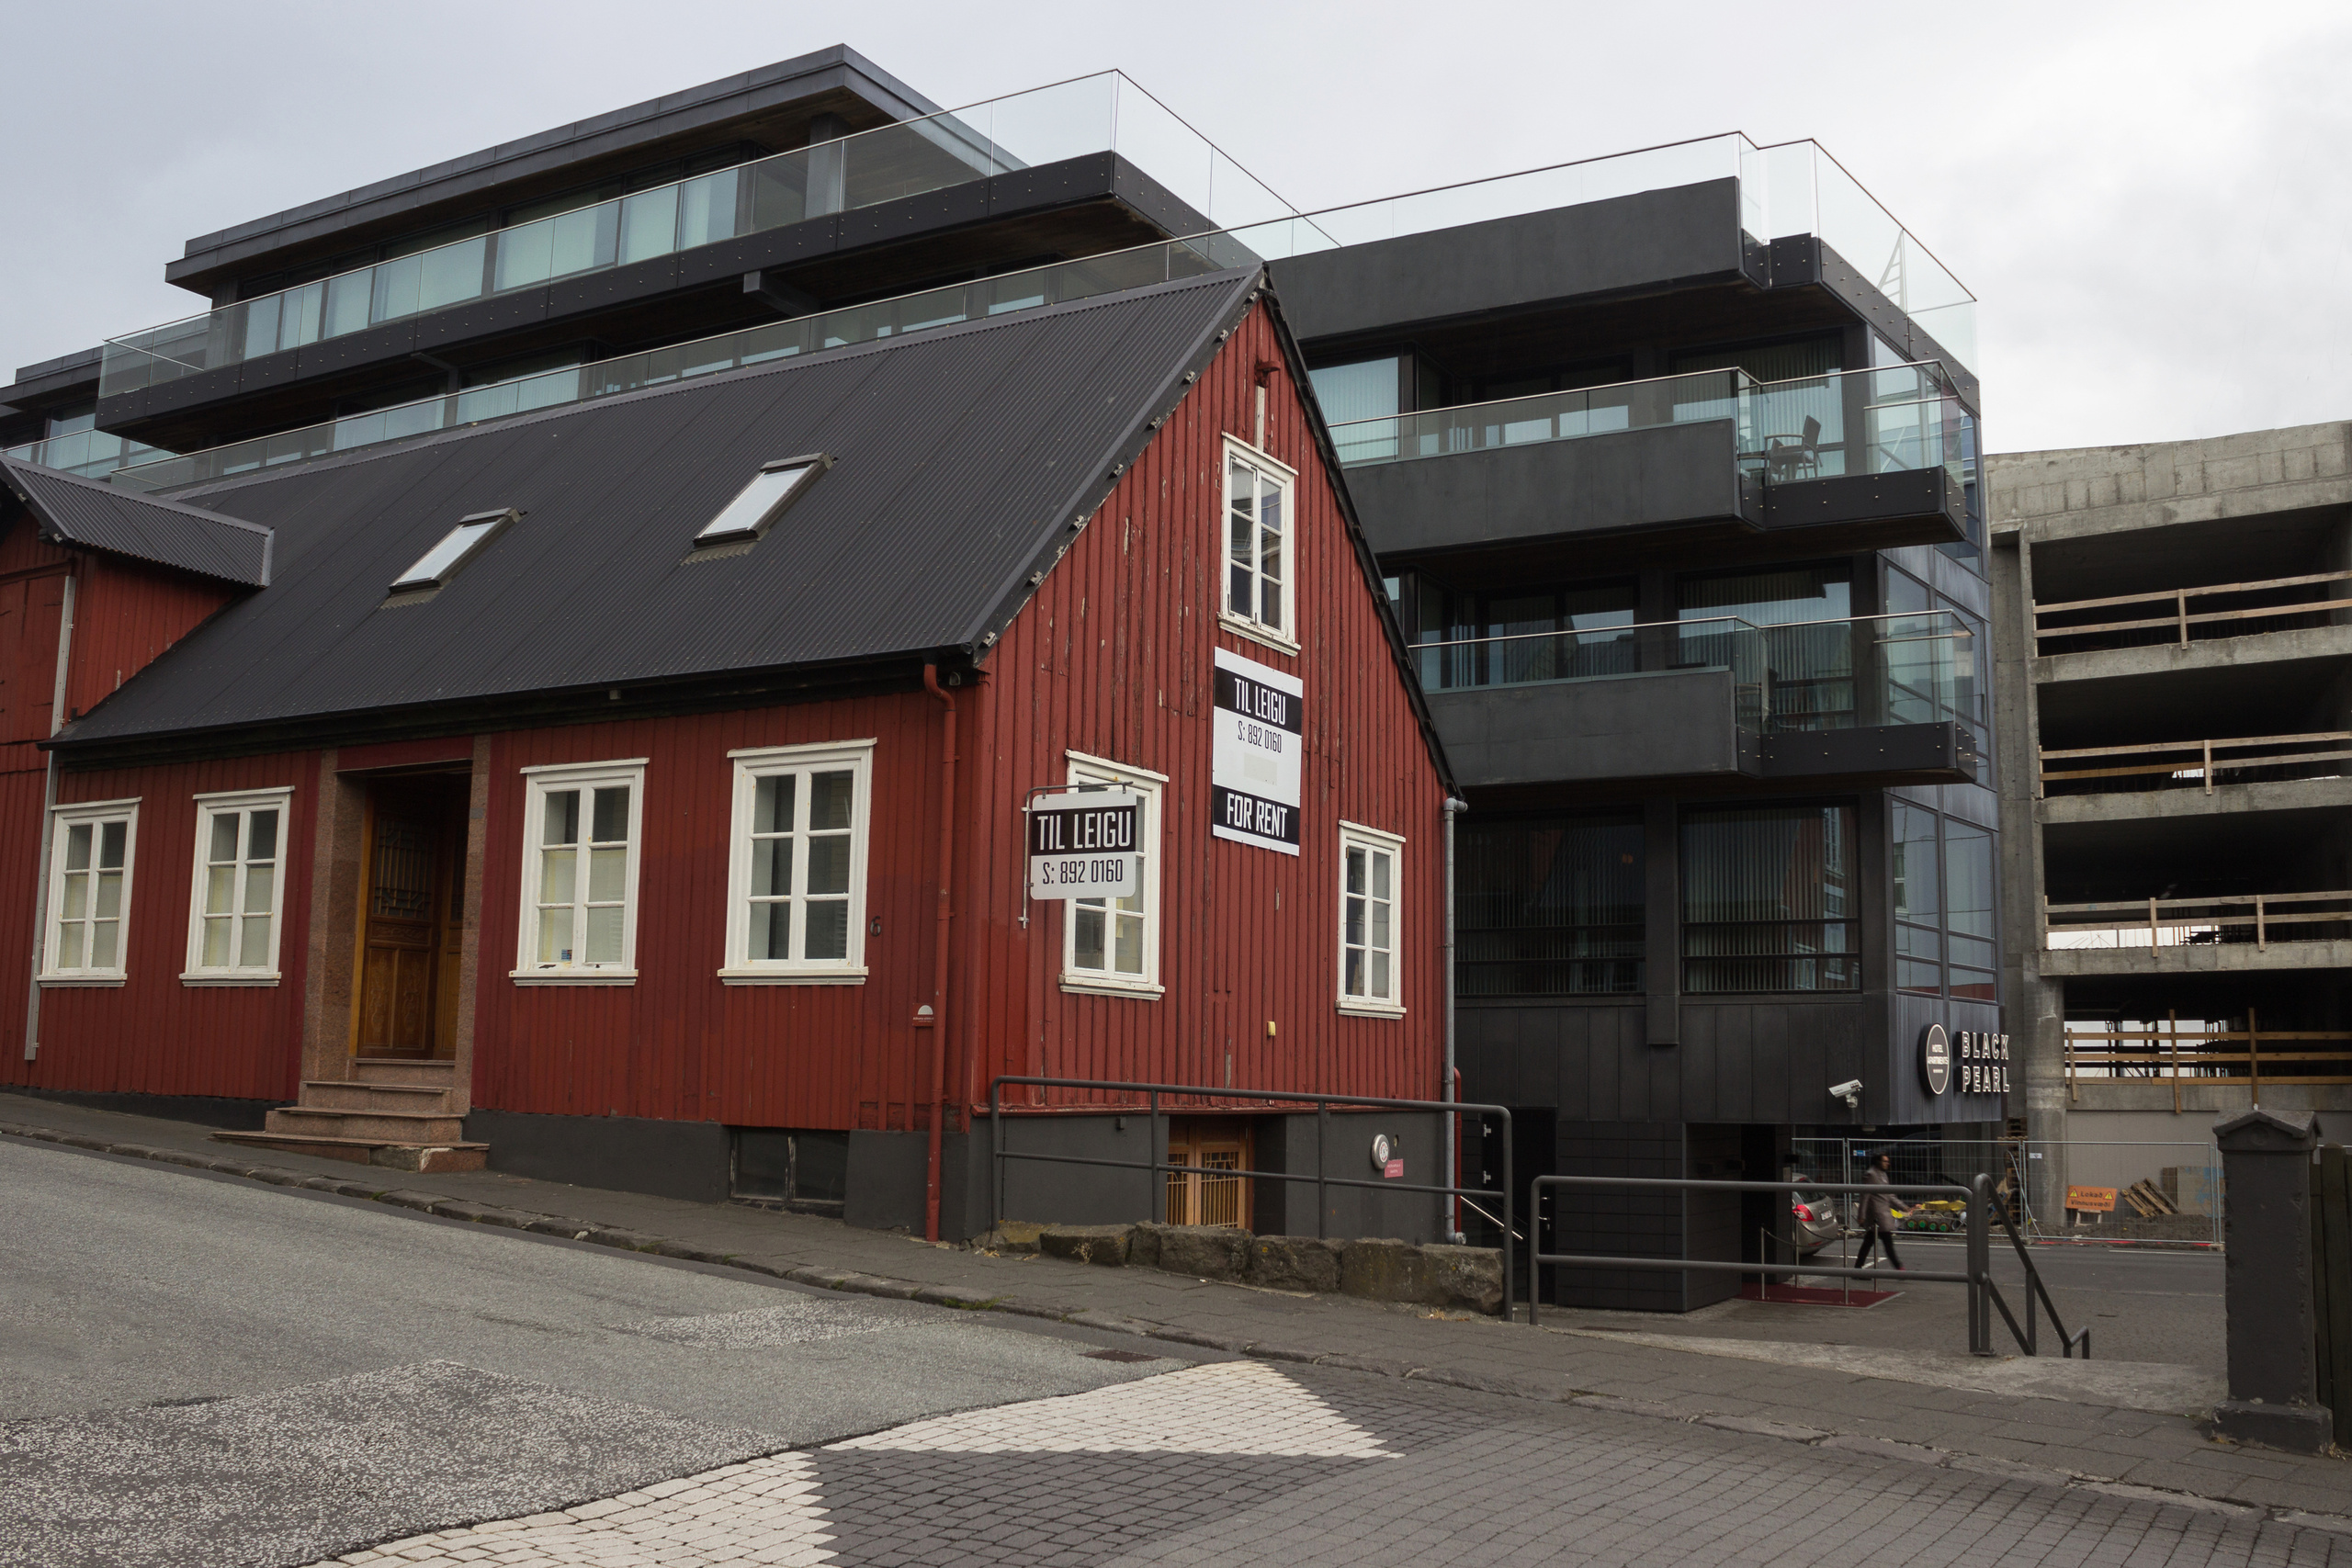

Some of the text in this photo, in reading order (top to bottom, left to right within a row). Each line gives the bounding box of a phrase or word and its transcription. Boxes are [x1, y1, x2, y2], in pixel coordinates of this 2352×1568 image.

[1234, 677, 1286, 726] TIL LEIGU
[1238, 720, 1283, 753] S: 892 0160
[1036, 811, 1132, 851] TIL LEIGU
[1227, 793, 1287, 838] FOR RENT
[1043, 859, 1124, 885] S: 892 0160
[869, 915, 881, 937] 6
[1962, 1031, 2009, 1060] BLACK
[1962, 1066, 2010, 1093] PEARL
